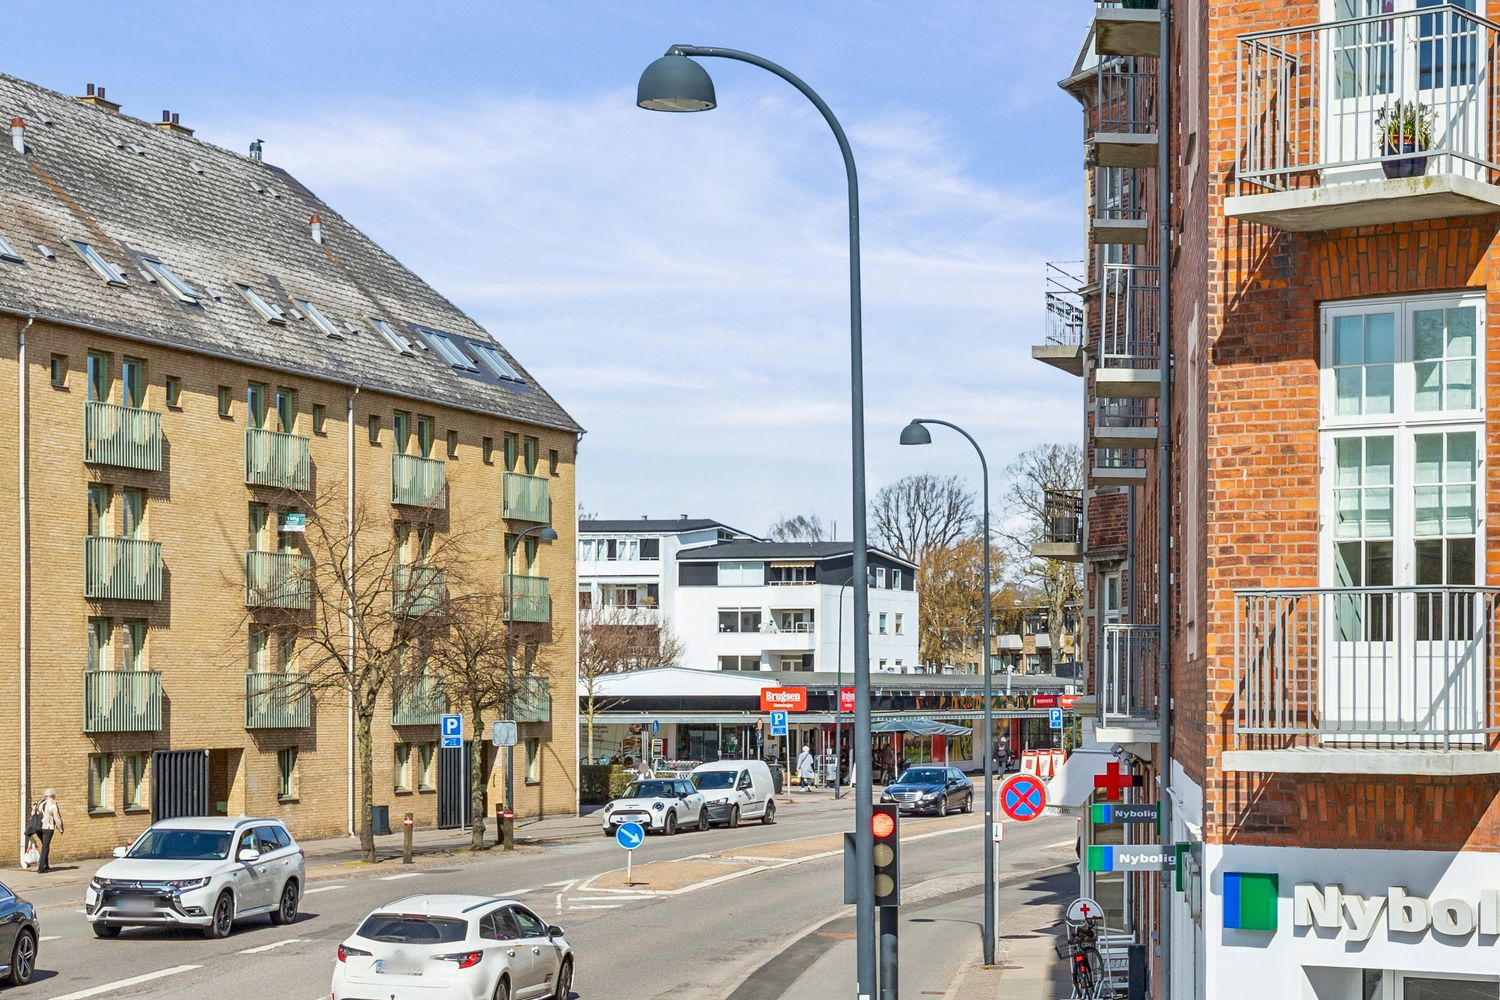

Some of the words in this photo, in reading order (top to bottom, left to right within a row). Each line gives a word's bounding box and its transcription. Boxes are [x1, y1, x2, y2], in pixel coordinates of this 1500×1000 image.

[765, 690, 801, 703] Brugsen
[774, 713, 784, 726] P
[447, 718, 458, 735] P
[1115, 810, 1157, 819] Nybolig
[1119, 853, 1176, 865] Nybolig
